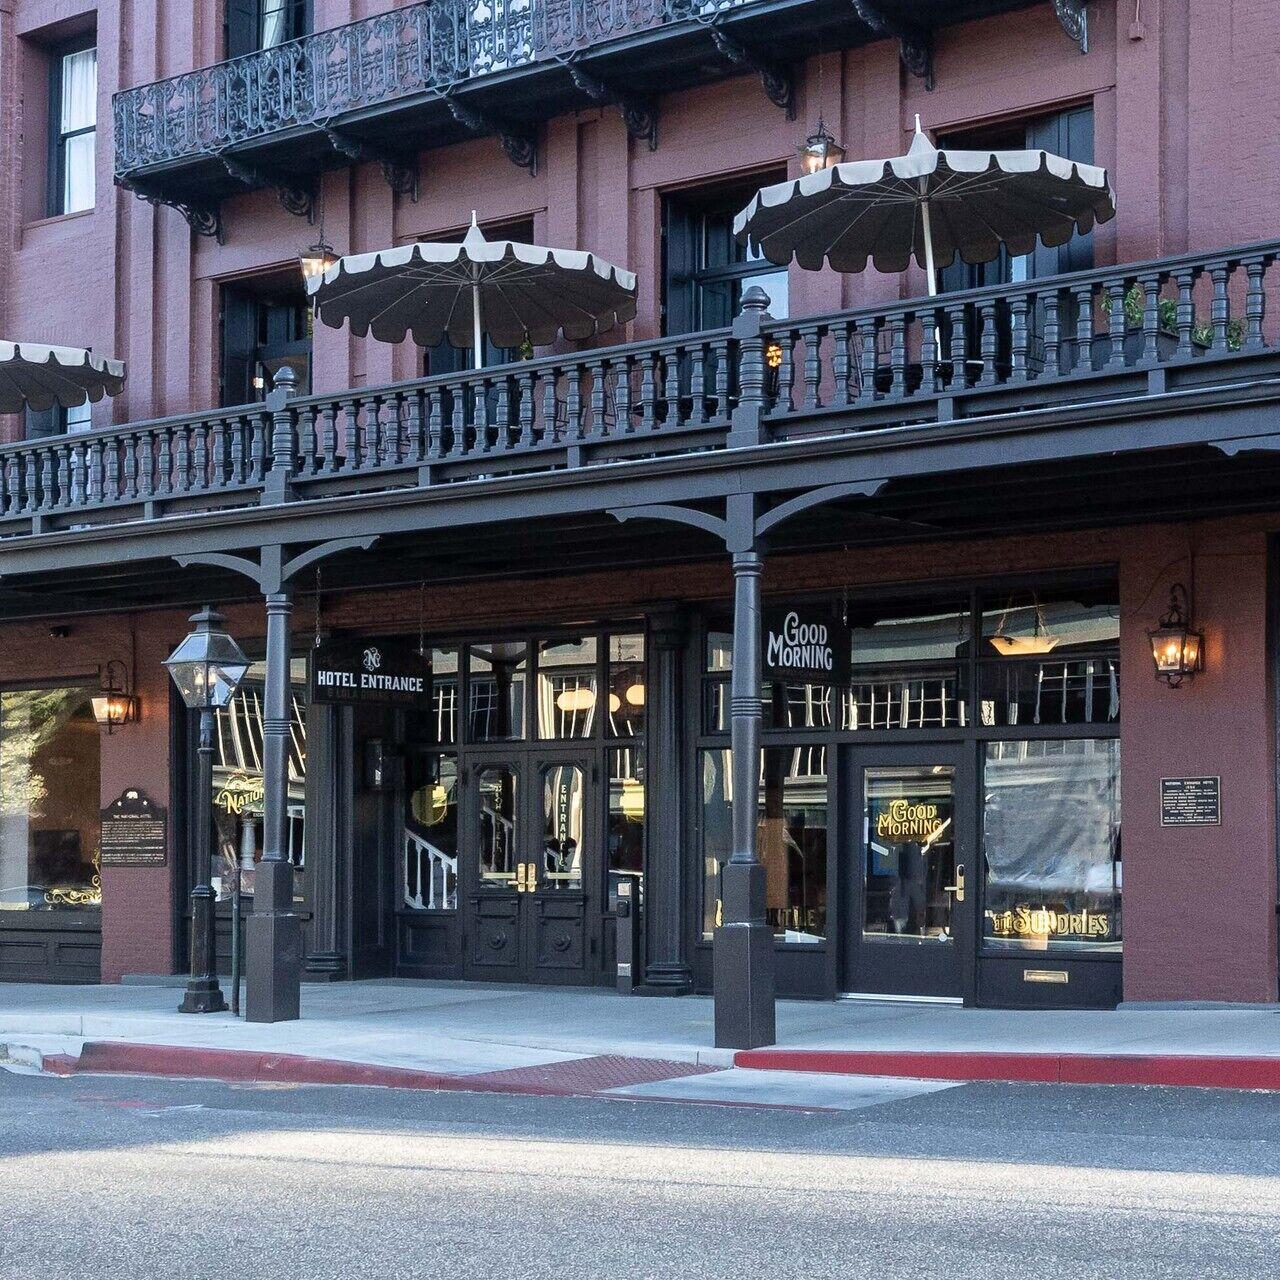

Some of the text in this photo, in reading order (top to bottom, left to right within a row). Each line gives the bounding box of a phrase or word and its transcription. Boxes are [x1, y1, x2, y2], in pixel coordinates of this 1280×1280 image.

[784, 611, 828, 646] GOOD
[767, 630, 833, 671] MORNING
[317, 670, 424, 692] HOTEL ENTRANCE
[891, 800, 935, 822] GOOD
